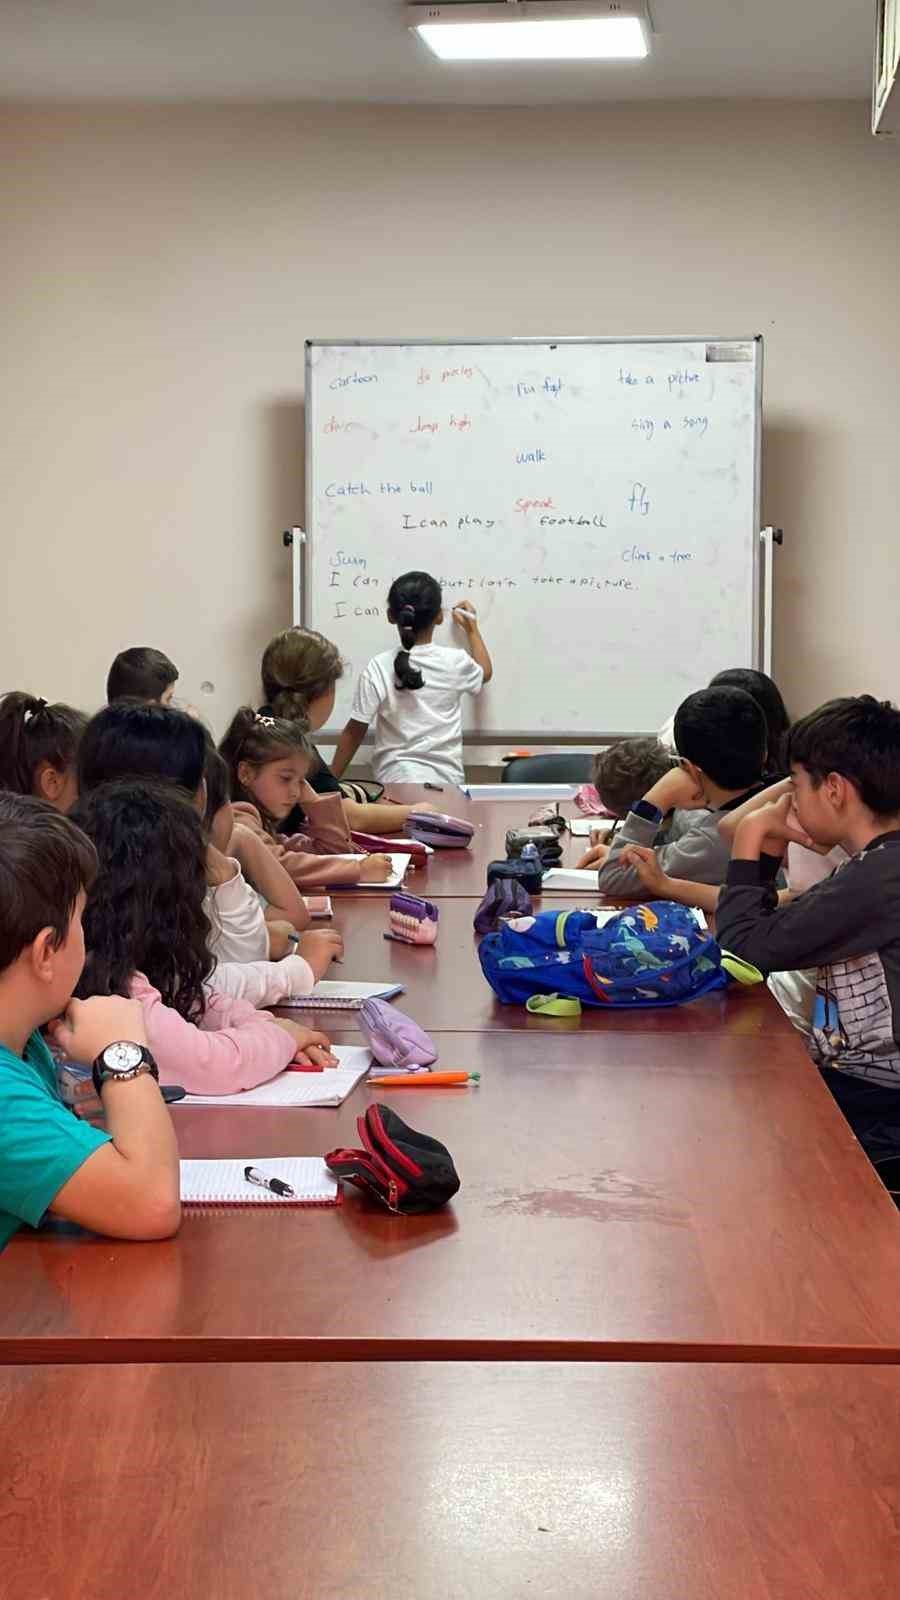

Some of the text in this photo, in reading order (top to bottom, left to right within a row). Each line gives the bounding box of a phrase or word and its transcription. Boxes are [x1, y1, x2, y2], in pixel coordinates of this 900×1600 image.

[645, 375, 656, 385] a
[663, 420, 673, 430] a
[515, 449, 547, 464] walk
[379, 481, 402, 495] the
[410, 481, 433, 496] ball
[626, 482, 651, 515] fly
[401, 514, 417, 530] I
[420, 518, 449, 529] can
[457, 516, 496, 530] play
[329, 571, 380, 587] I can
[532, 576, 563, 585] take
[333, 601, 380, 618] I can
